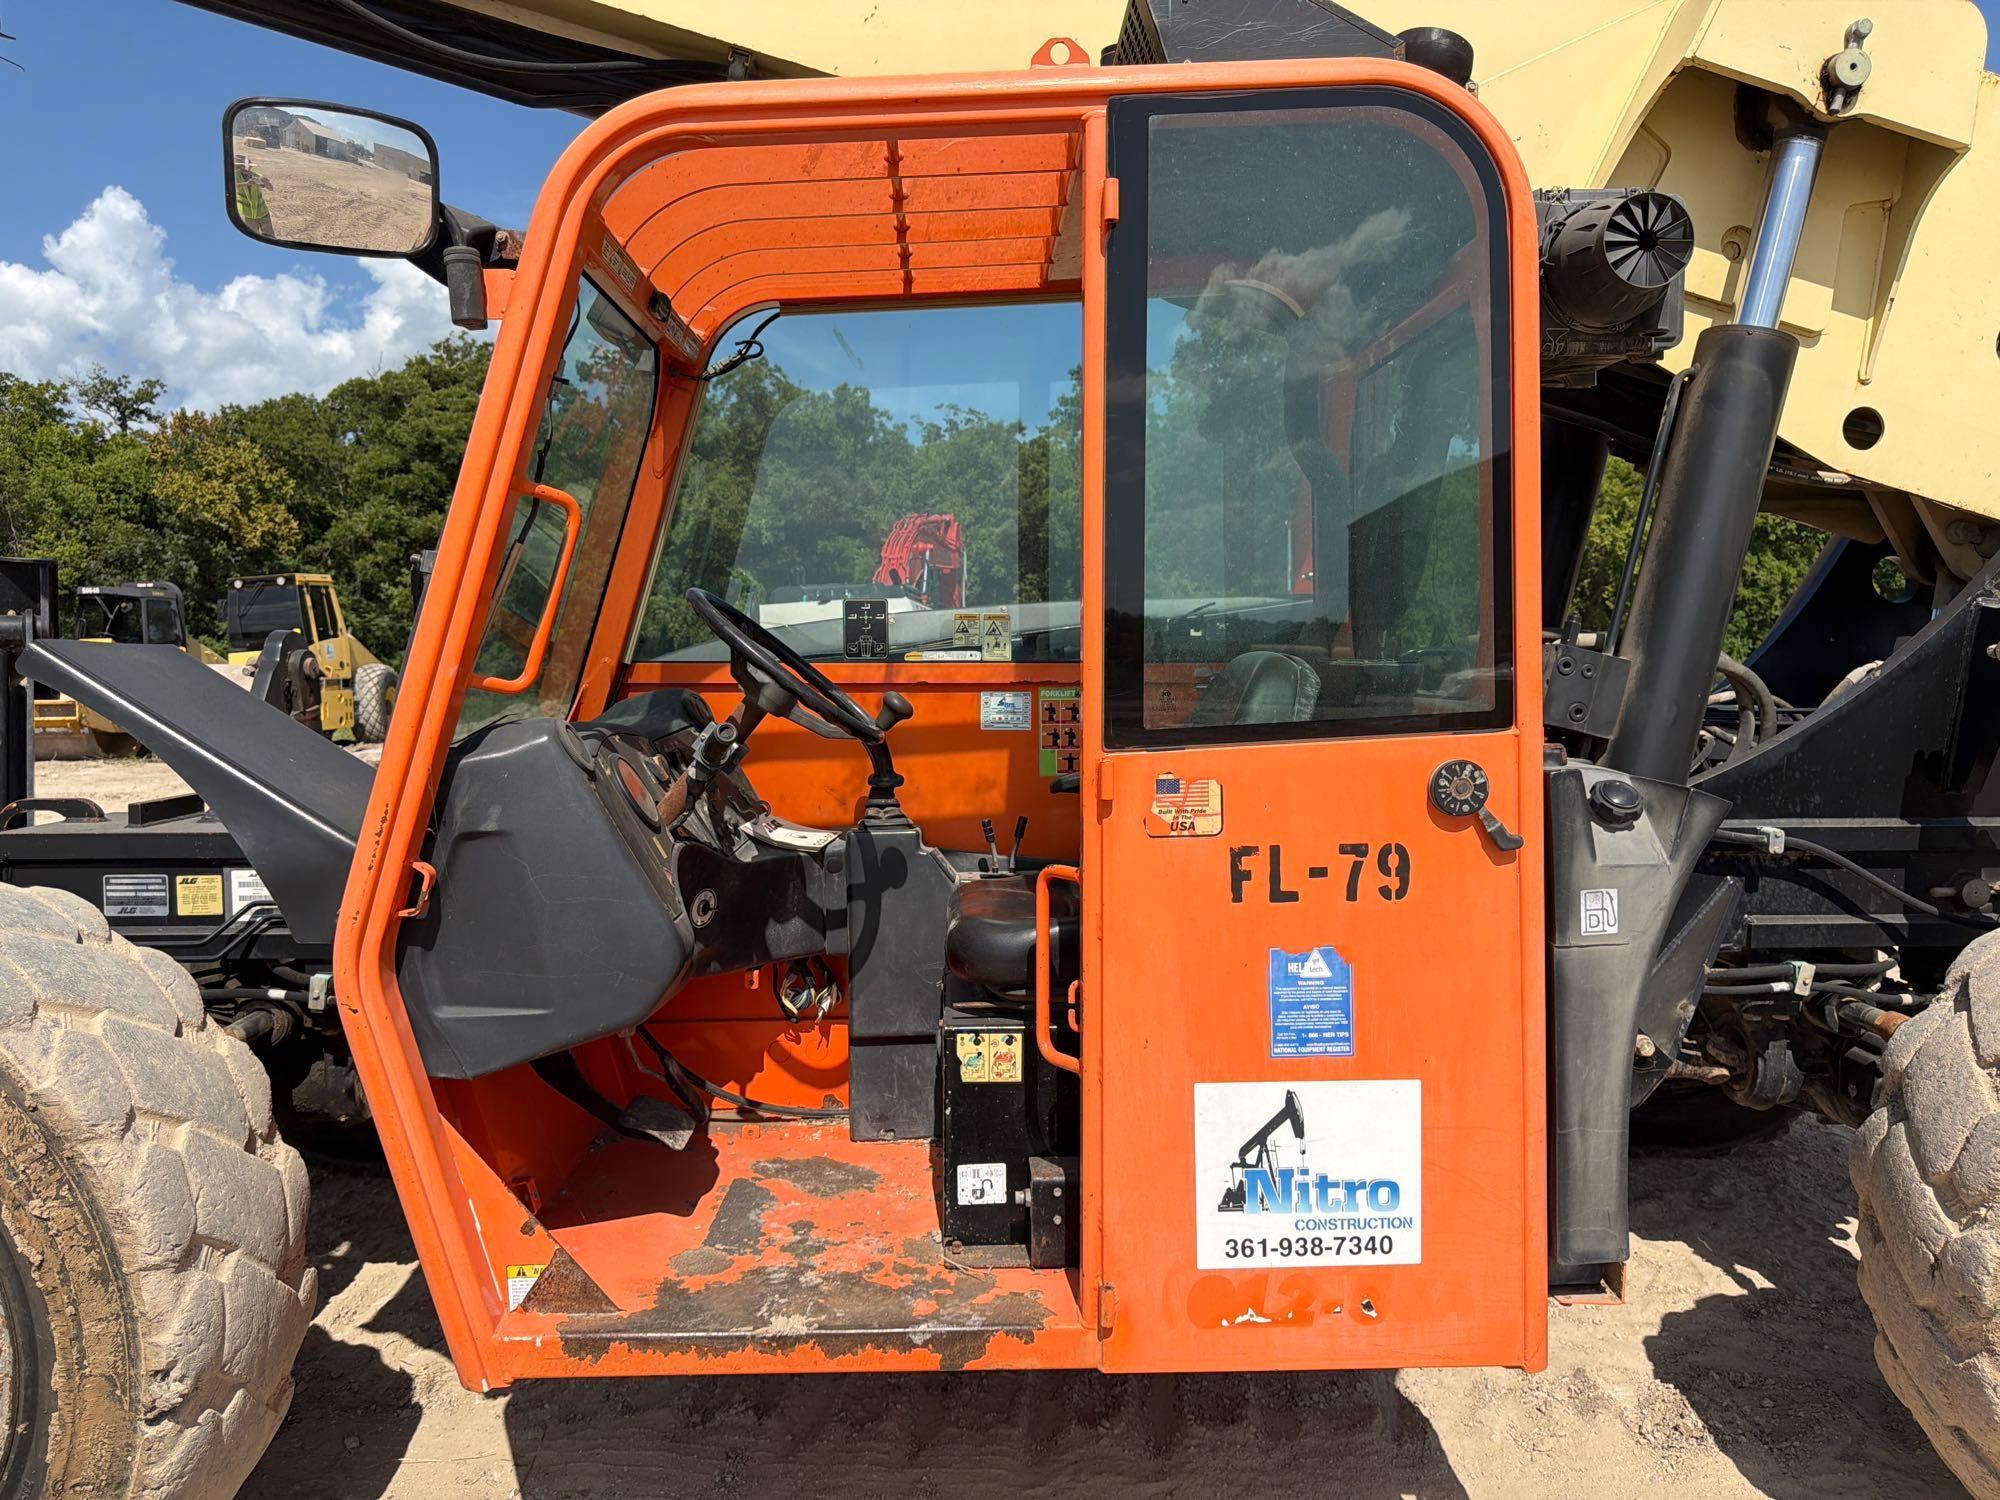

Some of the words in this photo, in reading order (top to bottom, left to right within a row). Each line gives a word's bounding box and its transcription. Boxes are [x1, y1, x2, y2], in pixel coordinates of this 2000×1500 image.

[1170, 821, 1196, 831] USA
[1229, 842, 1412, 903] FL-79
[1589, 914, 1600, 928] D
[1243, 1167, 1401, 1215] Nitro
[1294, 1216, 1413, 1231] CONSTRUCTION
[1225, 1235, 1393, 1258] 361-938-7340
